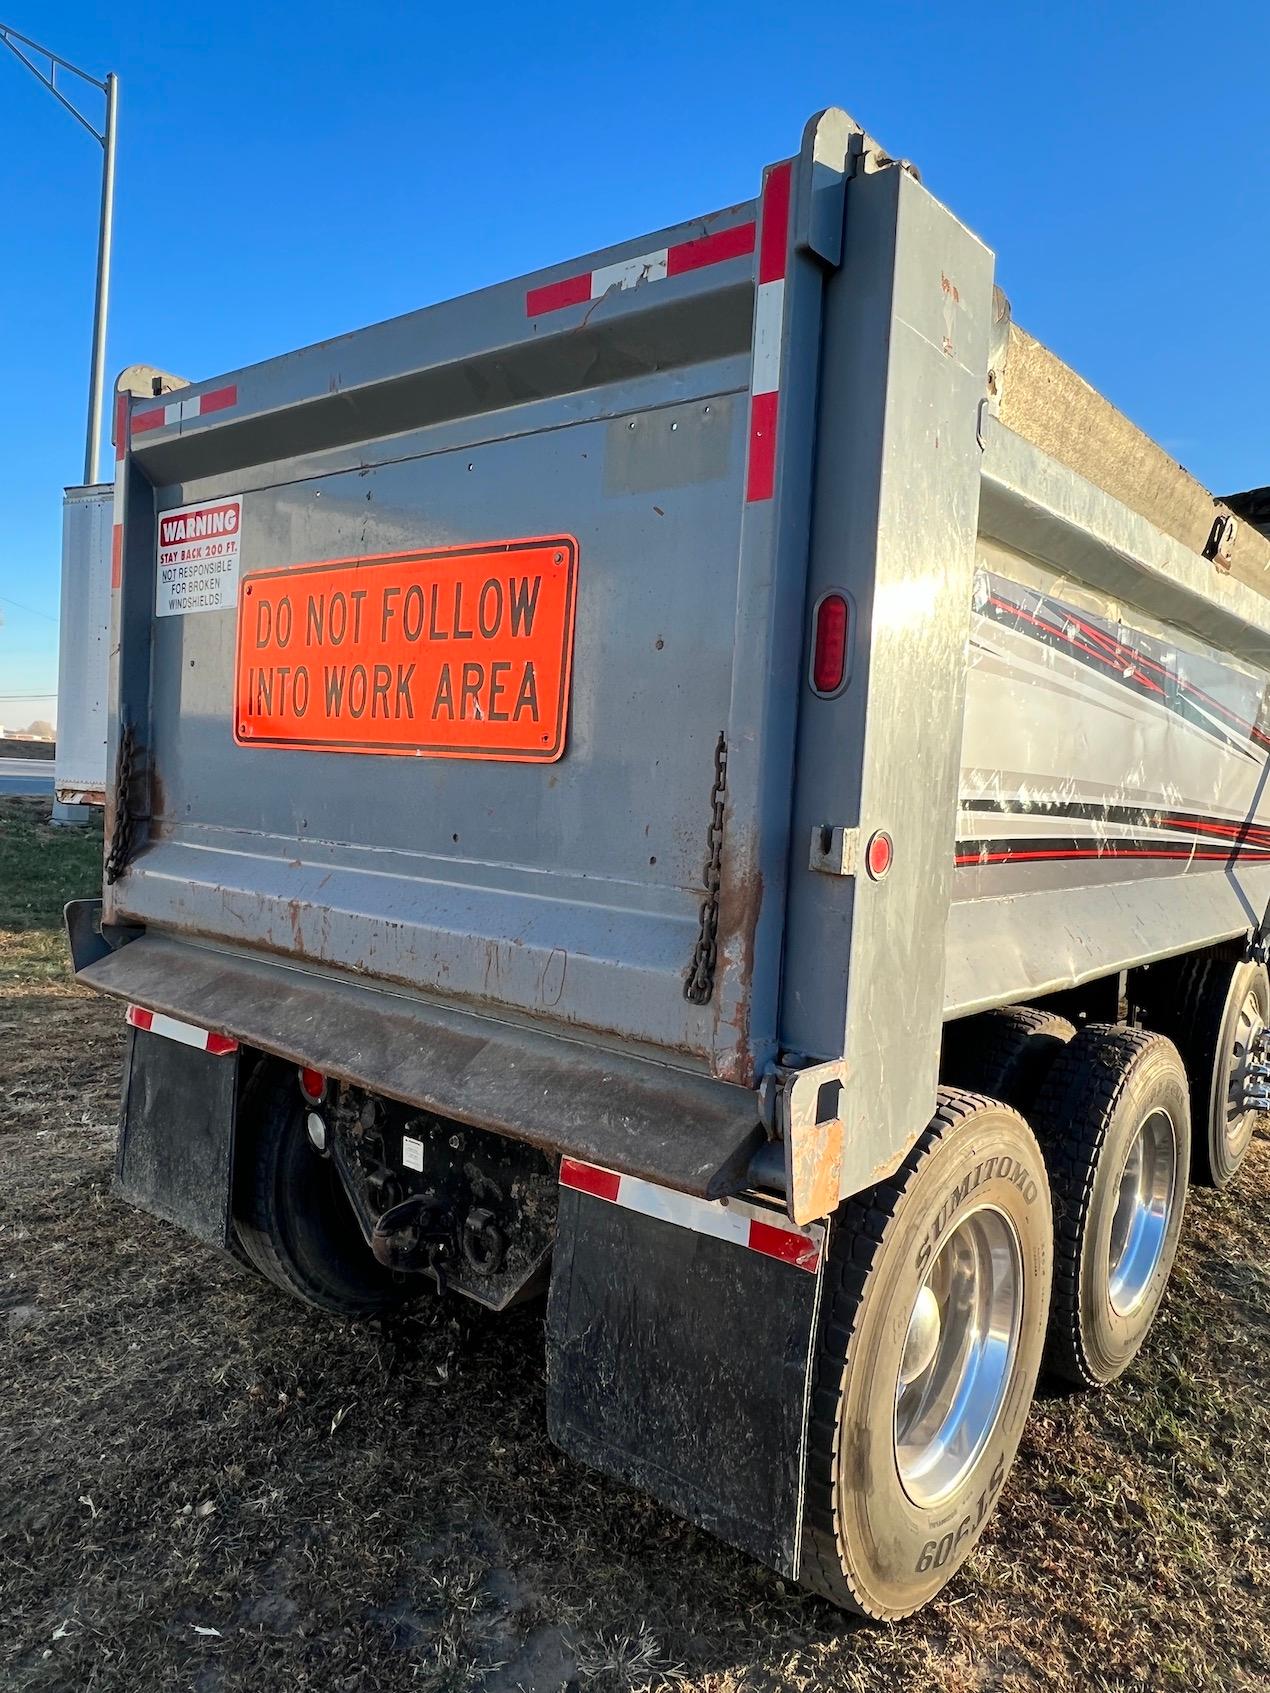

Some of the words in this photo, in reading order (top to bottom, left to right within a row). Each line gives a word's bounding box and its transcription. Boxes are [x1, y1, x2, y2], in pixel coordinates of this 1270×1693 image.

[162, 509, 237, 543] WARNING
[160, 551, 178, 564] STAY
[181, 547, 202, 561] BACK
[205, 544, 223, 556] 200
[226, 541, 238, 554] FT.
[162, 568, 176, 582] NOT
[179, 559, 232, 579] RESPONSIBLE
[171, 582, 187, 596] FOR
[188, 578, 220, 593] BROKEN
[168, 593, 223, 611] WINDSHIELDS!
[255, 596, 293, 649] DO
[306, 590, 367, 646] NOT
[381, 575, 542, 643] FOLLOW
[247, 665, 310, 718] INTO
[324, 663, 416, 719] WORK
[431, 661, 540, 723] AREA
[915, 1156, 1038, 1281] SUMITOMO
